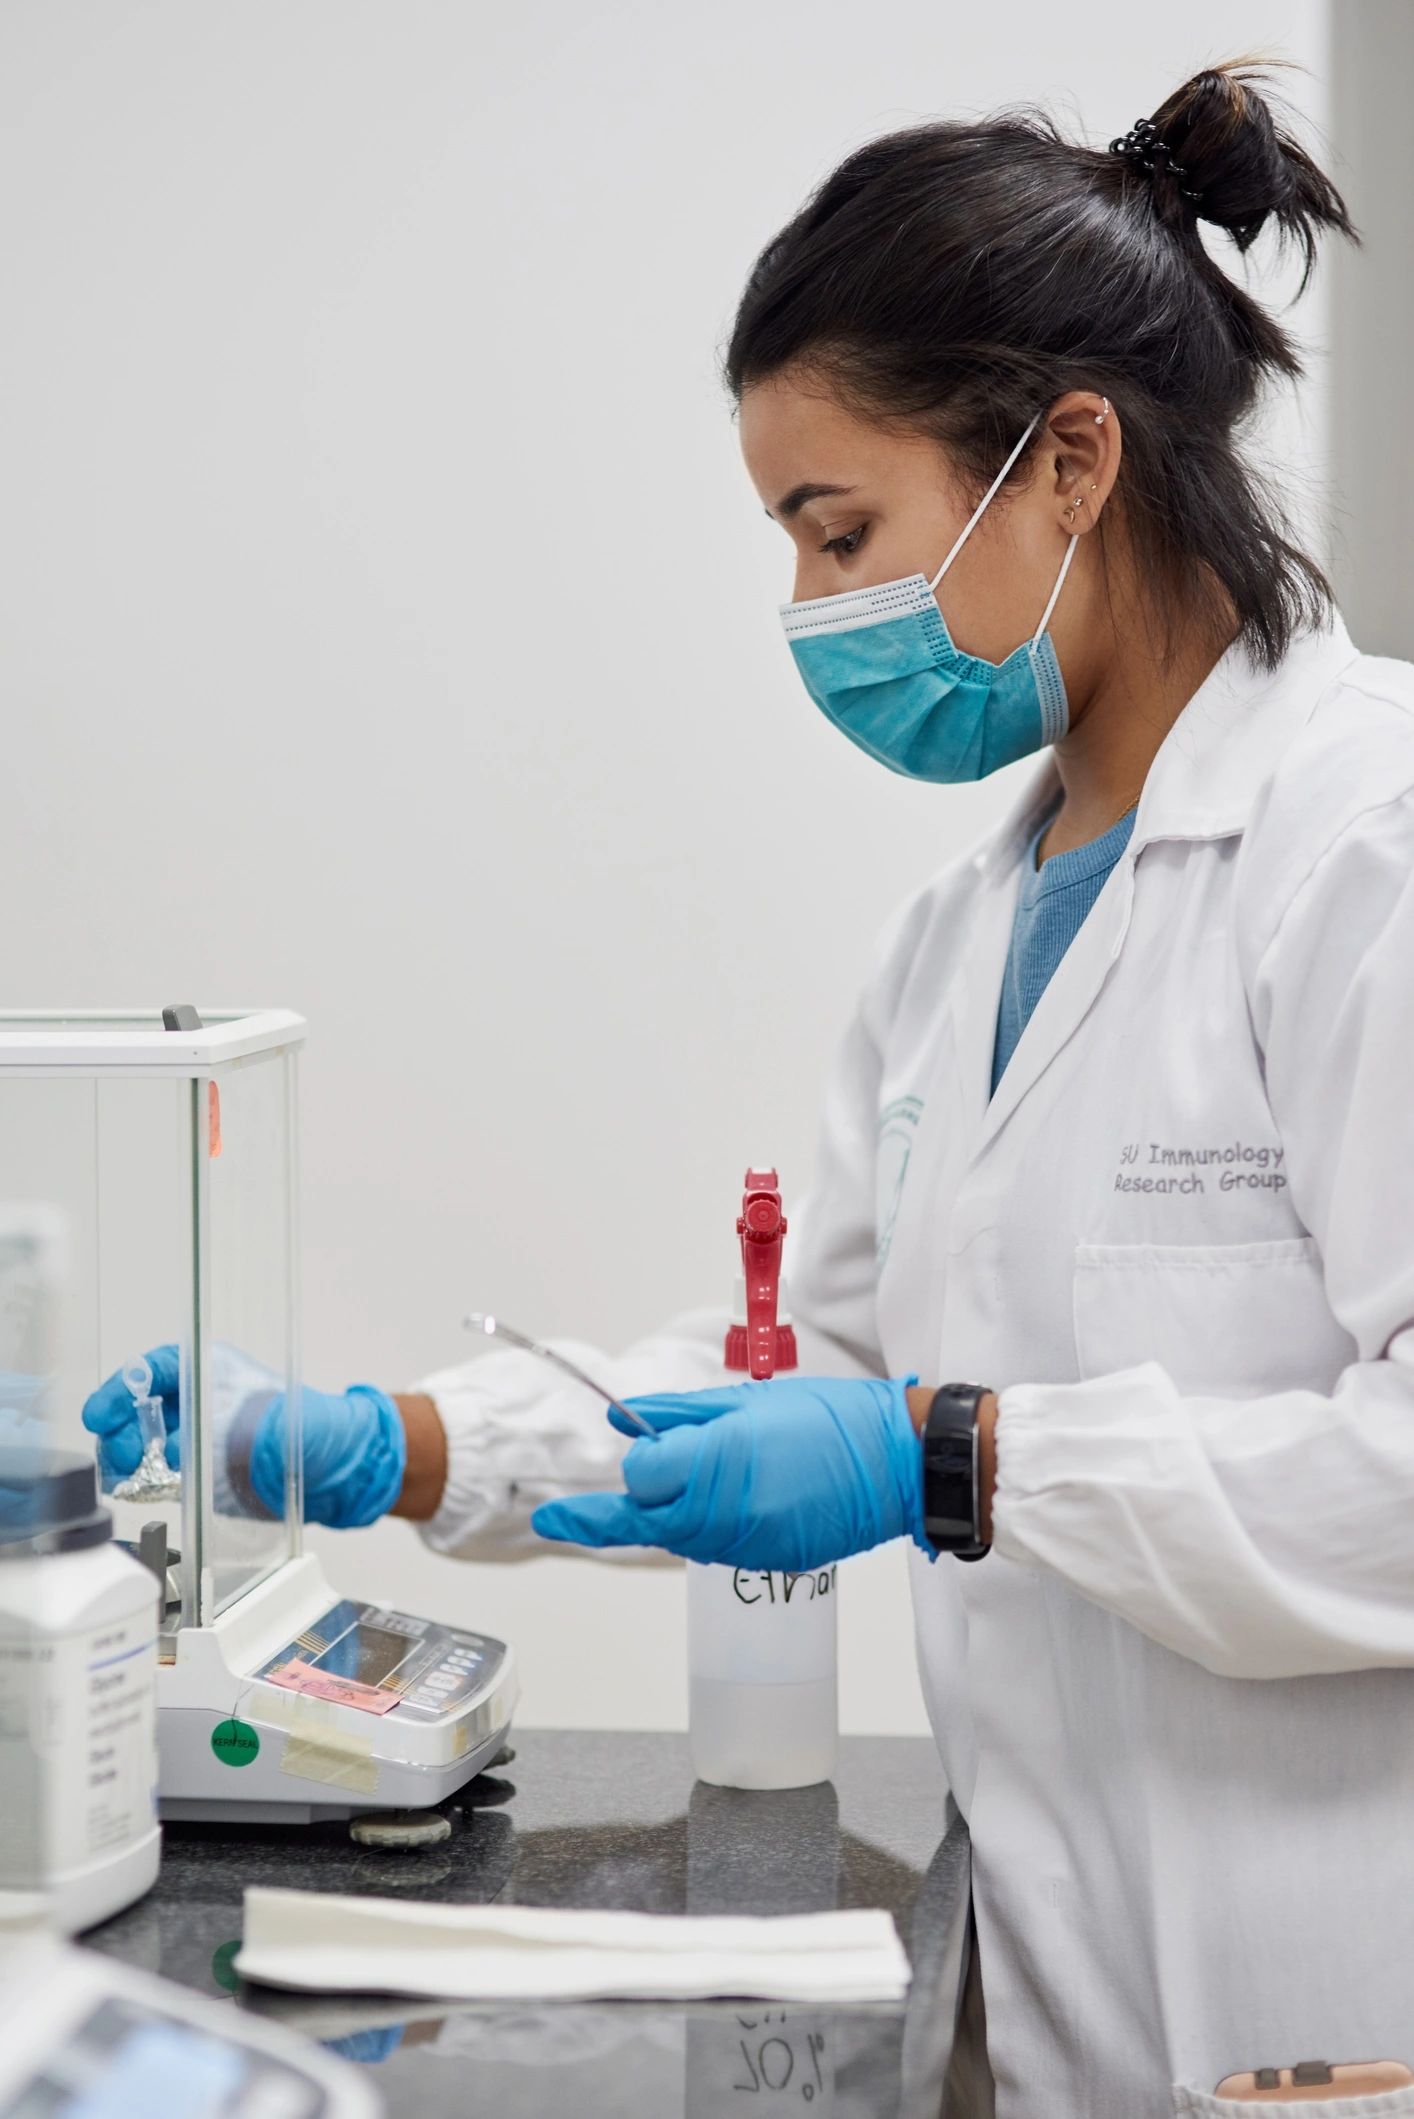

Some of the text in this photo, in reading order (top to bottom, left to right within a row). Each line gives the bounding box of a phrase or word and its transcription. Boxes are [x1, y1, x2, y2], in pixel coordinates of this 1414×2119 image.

[1149, 1141, 1284, 1169] Immunology
[1113, 1170, 1287, 1194] Research Group
